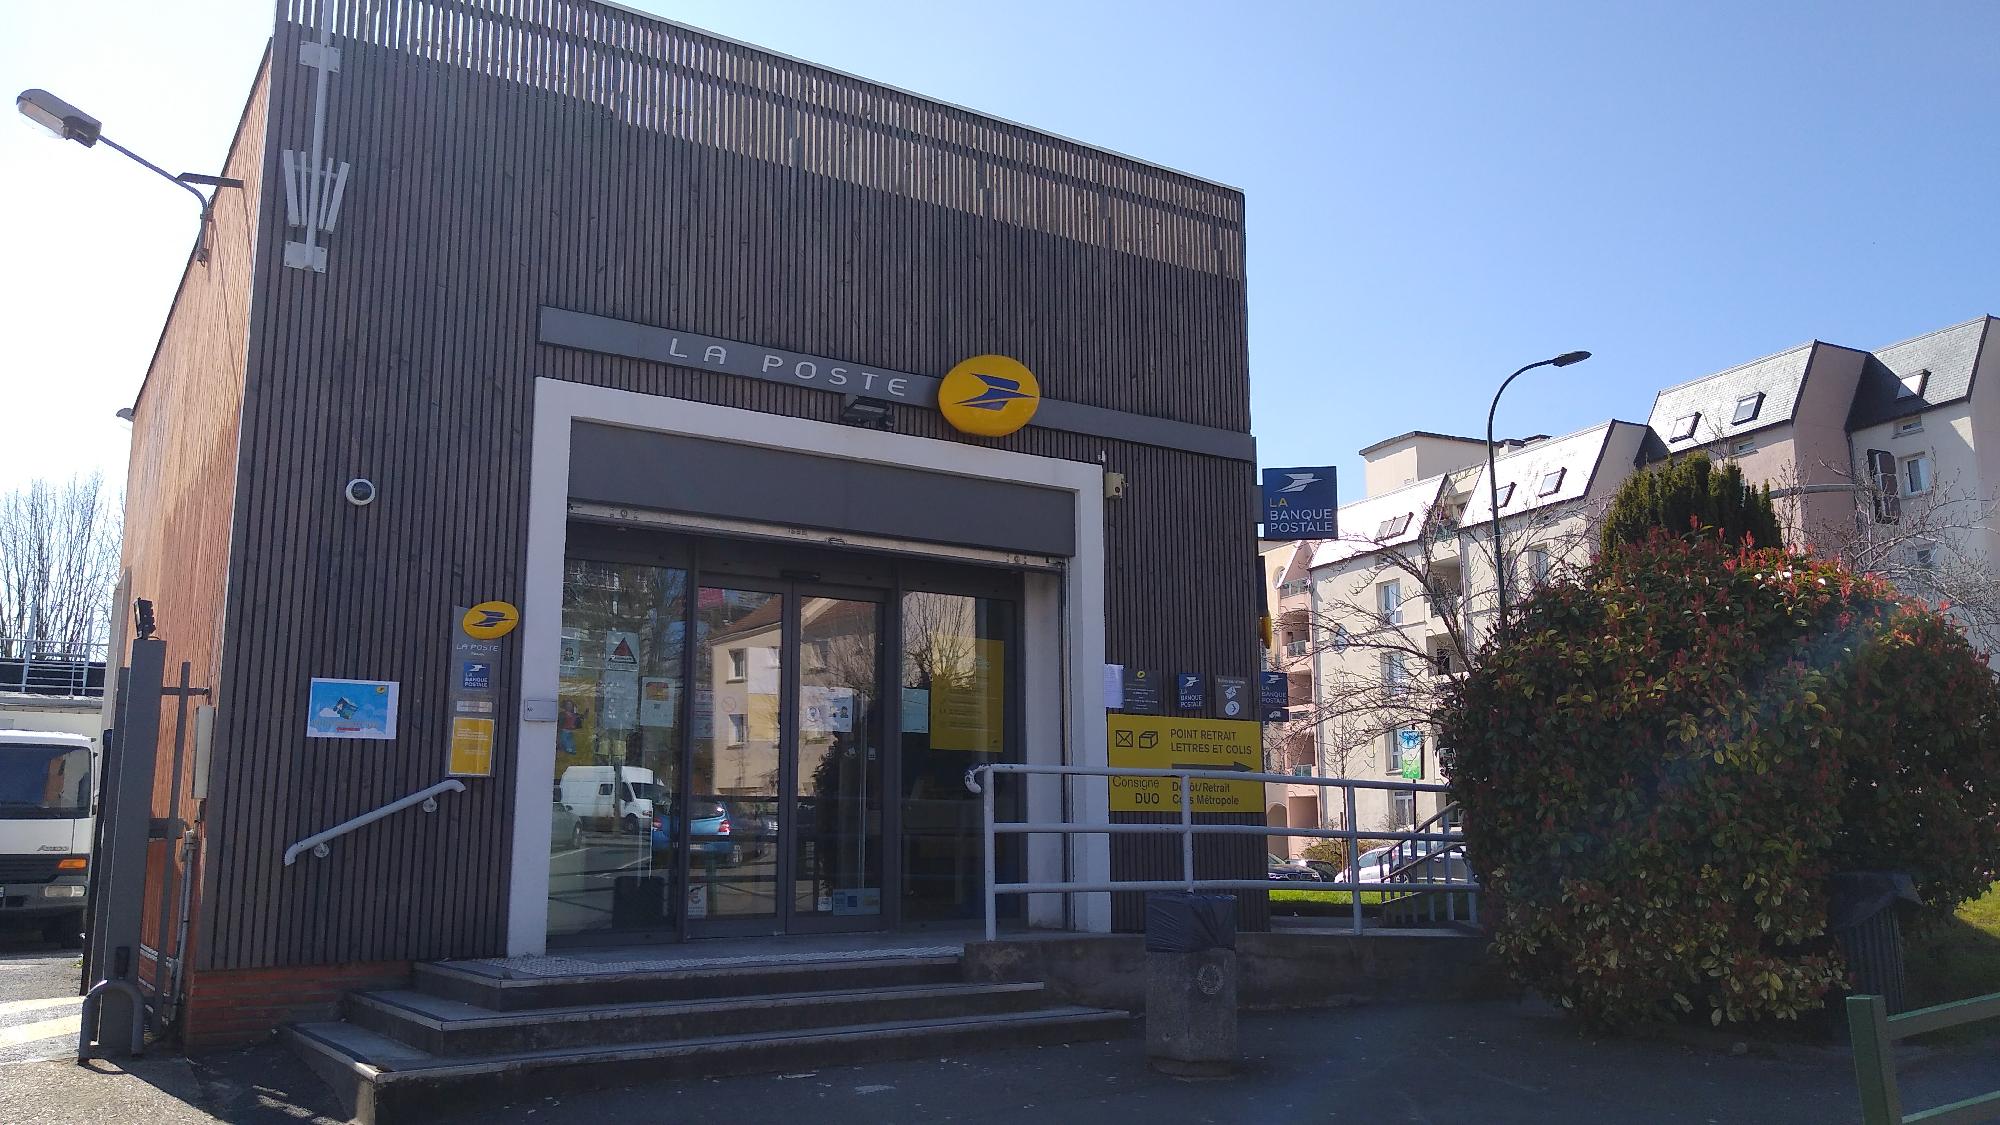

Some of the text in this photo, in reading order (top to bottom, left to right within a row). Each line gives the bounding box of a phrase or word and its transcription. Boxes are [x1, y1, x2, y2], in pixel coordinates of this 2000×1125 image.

[669, 338, 909, 397] LA POSTE
[1269, 497, 1288, 508] LA
[1270, 508, 1333, 521] BANQUE
[1270, 521, 1333, 533] POSTALE
[456, 643, 499, 652] LA POSTE
[1170, 728, 1237, 741] POINT RETRAIT
[1171, 742, 1252, 755] LETTRES ET COLIS
[1112, 776, 1160, 789] Consigne
[1172, 781, 1230, 793] Dôt/Retrait
[1135, 793, 1160, 804] DUO
[1197, 794, 1240, 806] Métropole
